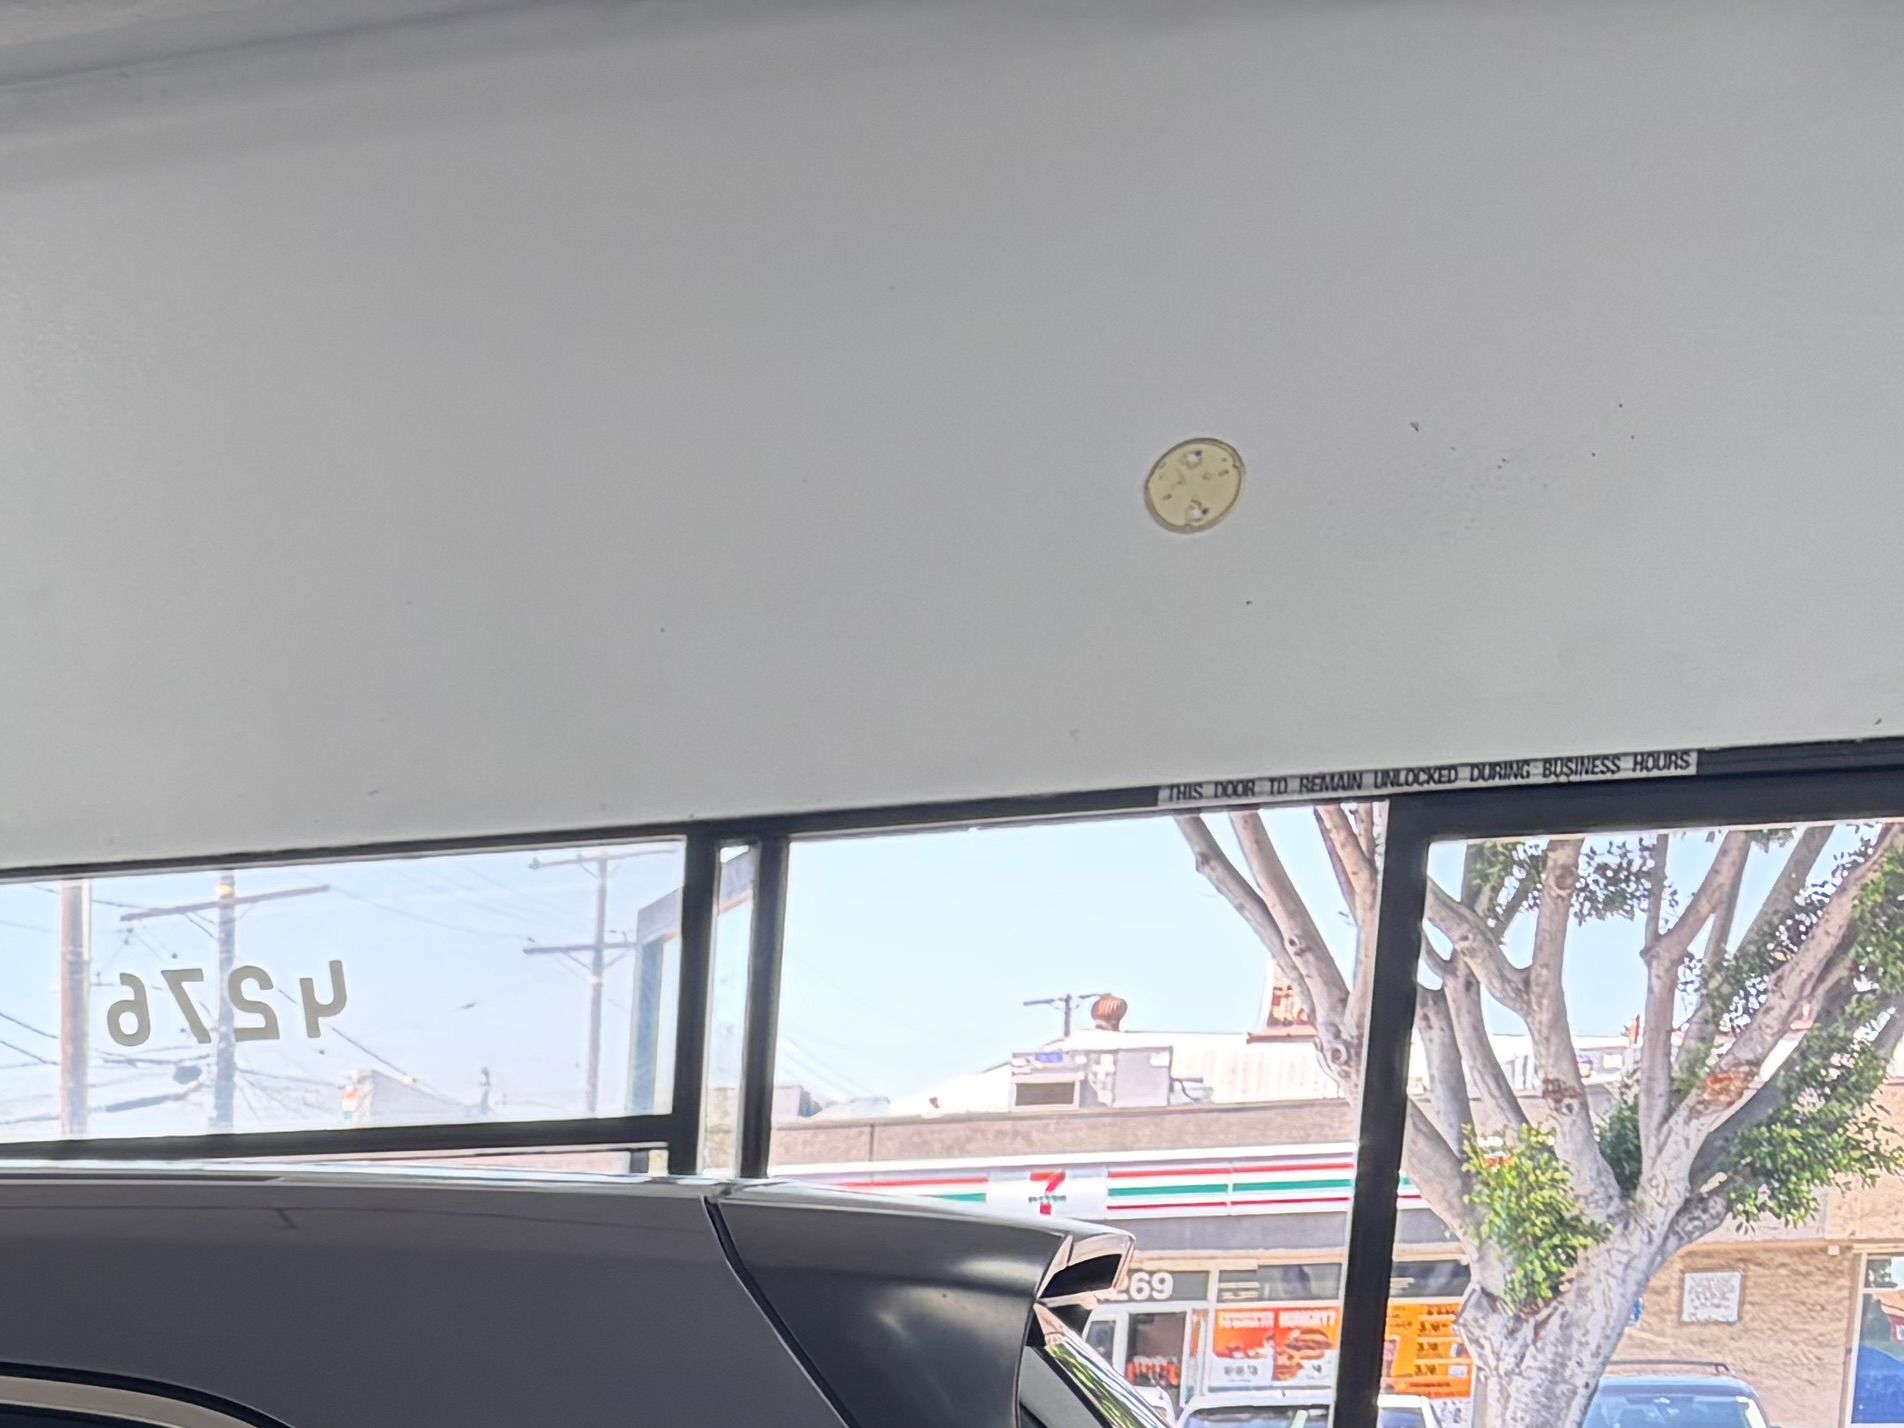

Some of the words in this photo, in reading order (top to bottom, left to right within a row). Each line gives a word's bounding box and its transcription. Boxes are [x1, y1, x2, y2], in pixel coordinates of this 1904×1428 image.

[1168, 783, 1204, 801] THIS
[1213, 778, 1256, 799] DOOR
[1267, 776, 1289, 795] TO
[1298, 771, 1363, 793] REMAIN
[1373, 764, 1459, 789] UNLOCKED
[1468, 761, 1531, 783] DURING
[1541, 755, 1622, 779] BUSINESS
[1631, 750, 1692, 773] HOURS
